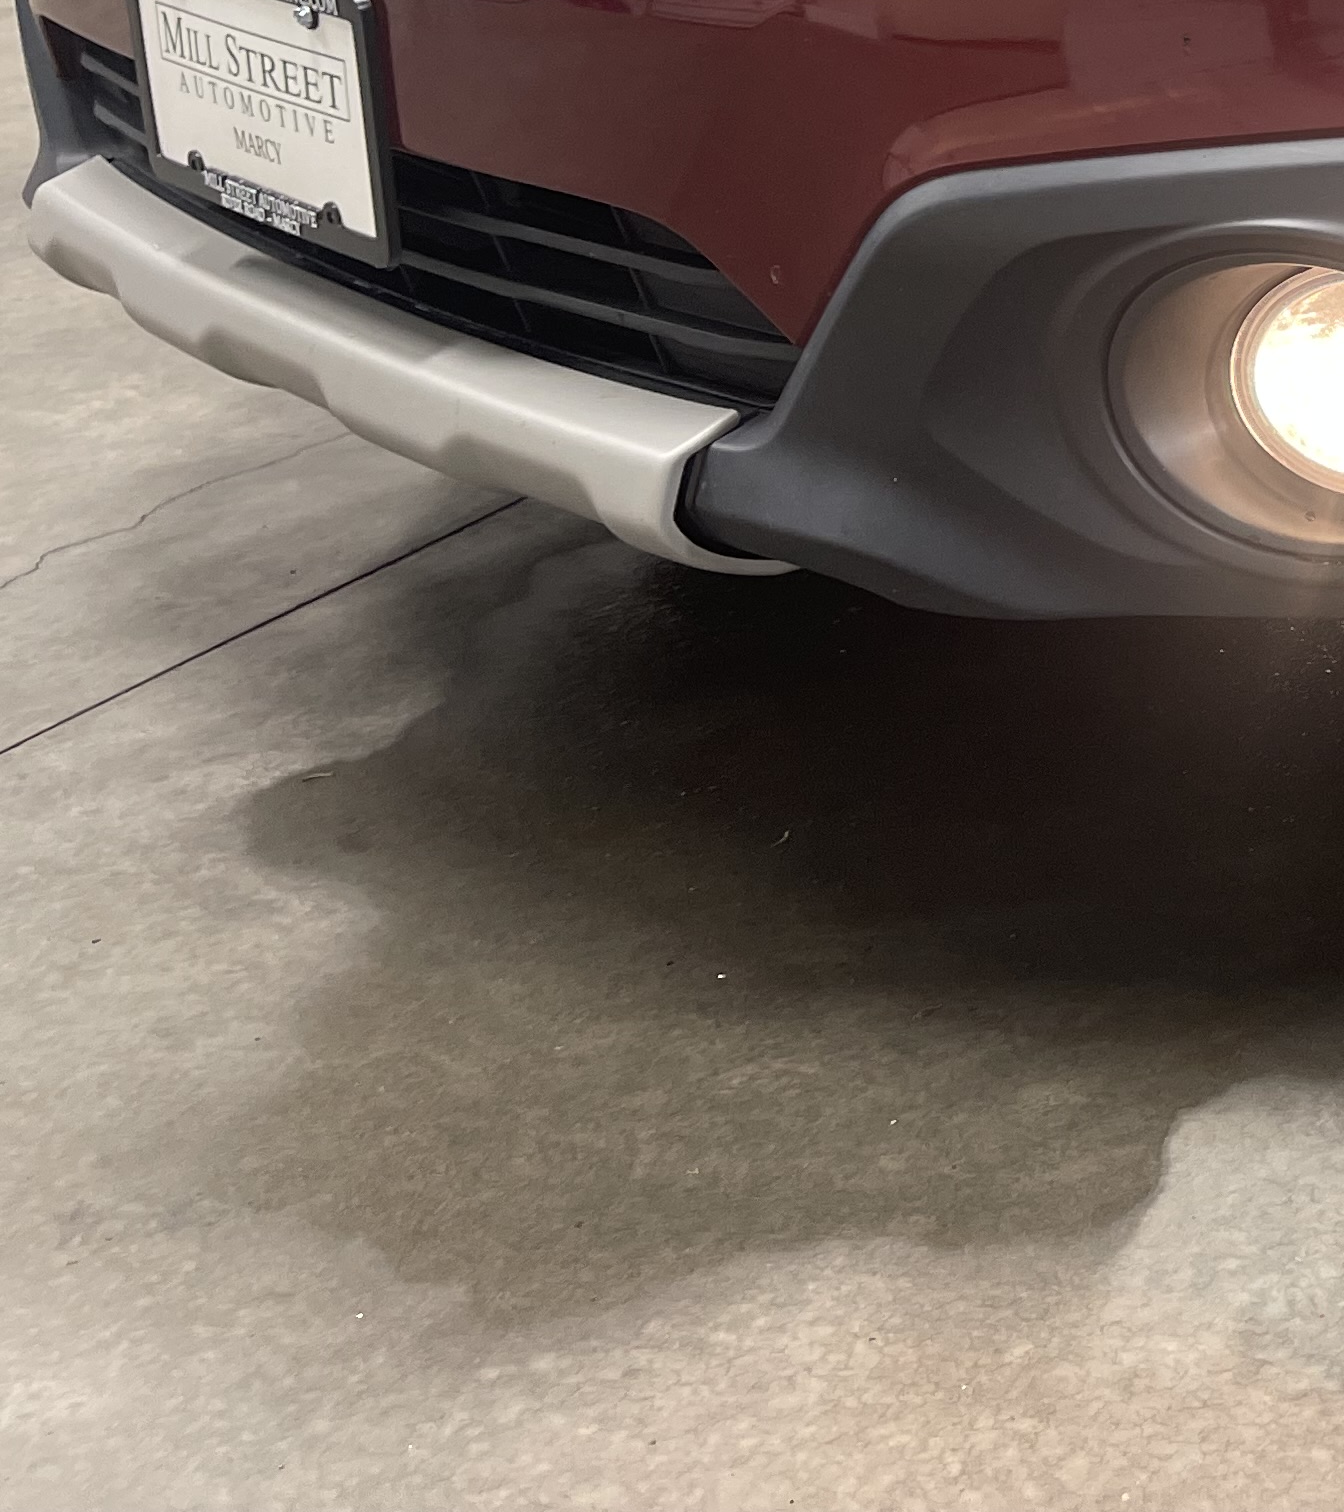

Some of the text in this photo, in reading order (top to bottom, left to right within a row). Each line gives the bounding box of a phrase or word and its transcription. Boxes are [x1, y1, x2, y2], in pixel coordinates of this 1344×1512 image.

[161, 10, 343, 111] MILL STREET
[179, 71, 335, 144] AUTOMOTIVE
[233, 126, 283, 165] MARCY
